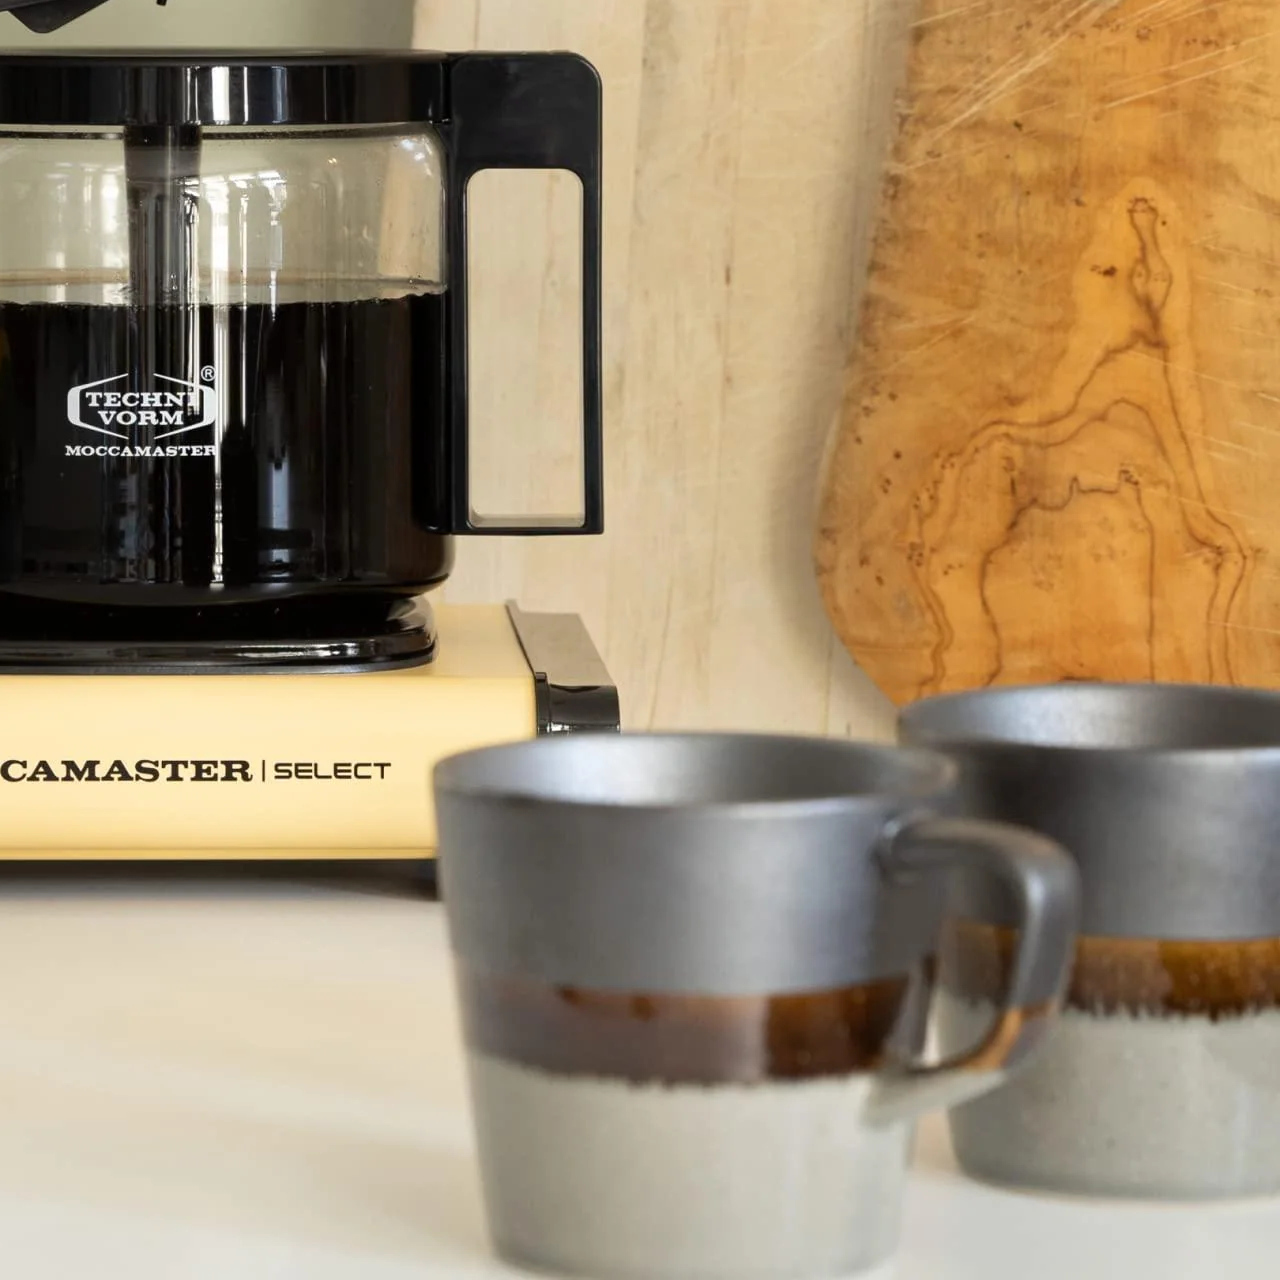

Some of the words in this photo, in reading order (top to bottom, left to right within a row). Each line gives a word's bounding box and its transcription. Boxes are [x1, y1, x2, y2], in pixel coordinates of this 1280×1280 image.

[97, 410, 184, 426] VORM
[65, 445, 217, 457] MOCCAMASTER
[274, 762, 392, 780] SELECT
